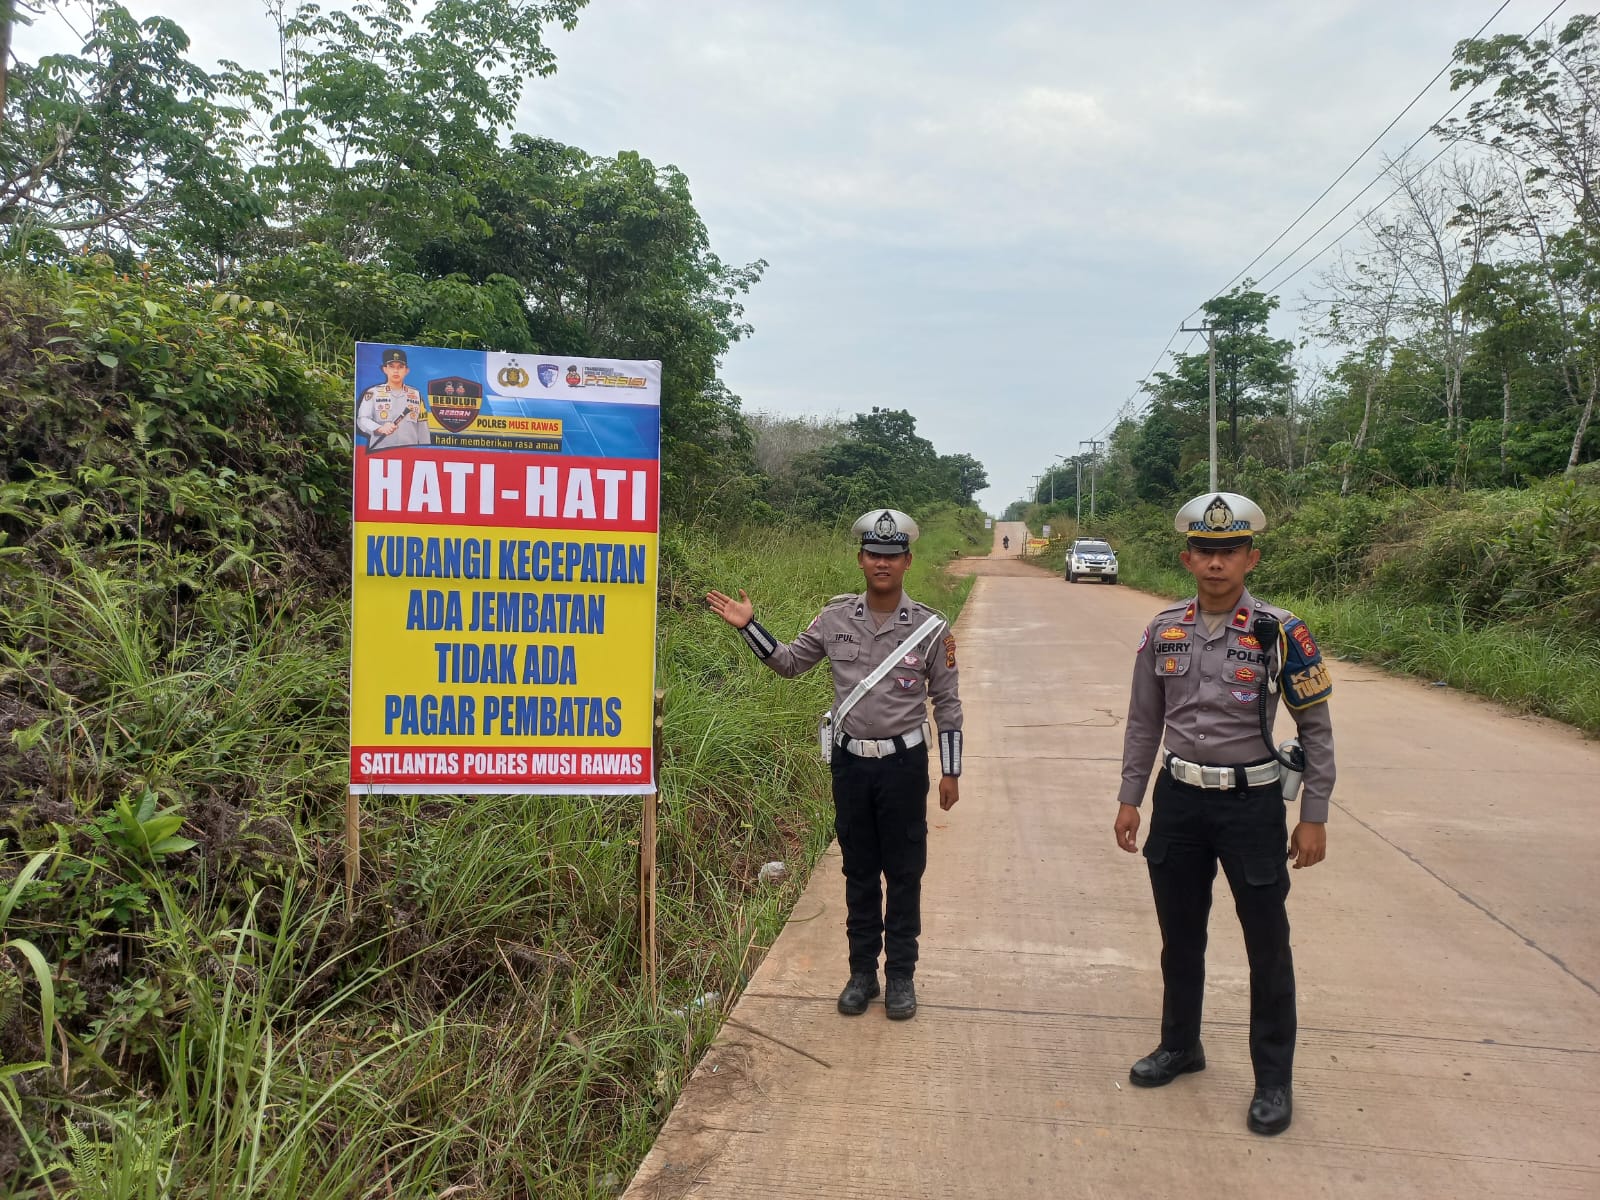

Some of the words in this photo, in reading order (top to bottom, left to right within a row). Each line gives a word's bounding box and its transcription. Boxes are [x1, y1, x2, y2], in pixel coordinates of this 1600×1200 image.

[432, 395, 477, 407] BEDULUR
[438, 409, 471, 417] REBORN
[477, 418, 507, 429] POLRES
[508, 420, 529, 430] MUSI
[531, 421, 559, 432] RAWAS
[435, 435, 459, 445] hadir
[461, 437, 513, 448] memberikan
[515, 441, 533, 449] rasa
[536, 442, 559, 450] aman
[367, 458, 647, 521] HATI-HATI
[366, 535, 491, 580] KURANGI
[498, 539, 646, 584] KECEPATAN
[406, 589, 463, 631] ADA
[469, 592, 606, 635] JEMBATAN
[835, 633, 854, 642] IPUL
[1156, 642, 1191, 654] JERRY
[434, 642, 518, 684] TIDAK
[522, 644, 577, 685] ADA
[384, 694, 476, 736] PAGAR
[482, 695, 622, 737] PEMBATAS
[360, 752, 459, 775] SATLANTAS
[463, 752, 528, 775] POLRES
[532, 753, 577, 775] MUSI
[580, 753, 643, 776] RAWAS
